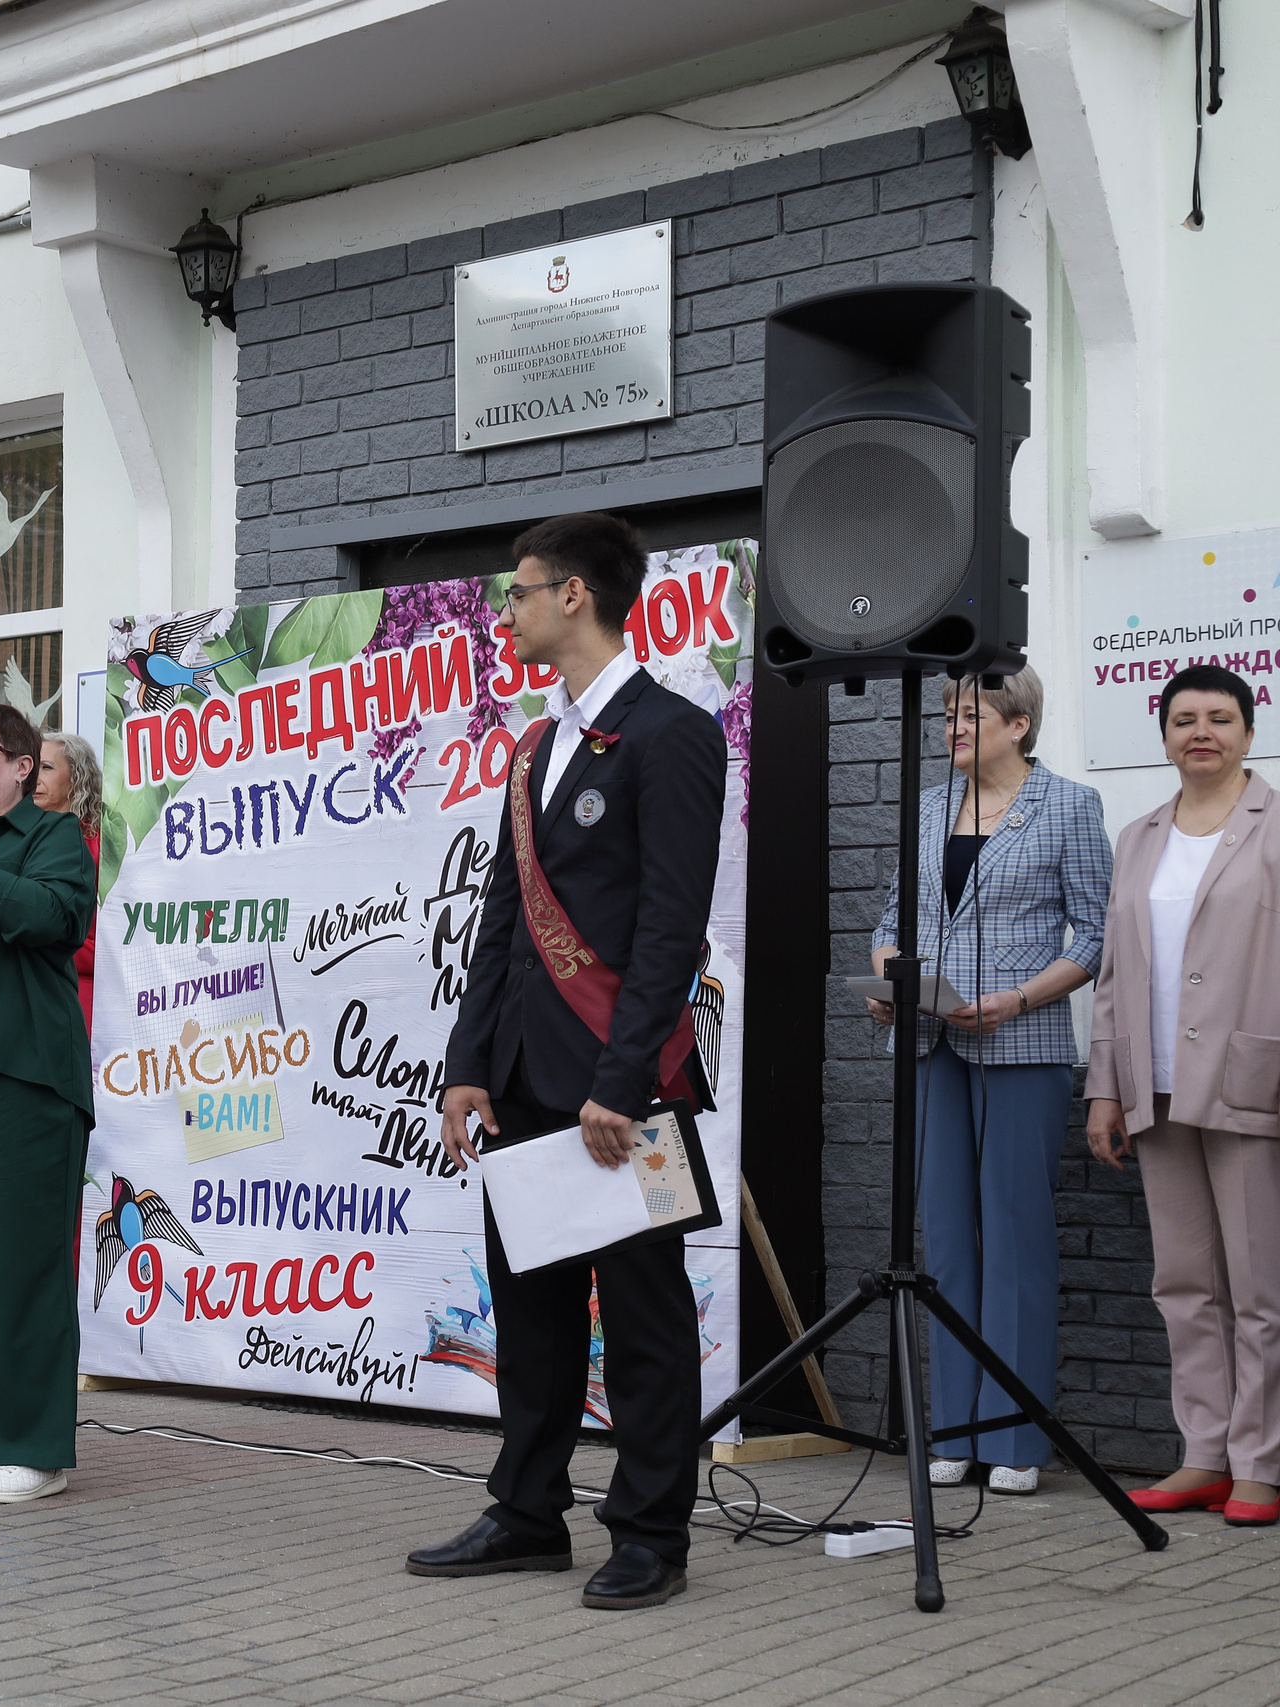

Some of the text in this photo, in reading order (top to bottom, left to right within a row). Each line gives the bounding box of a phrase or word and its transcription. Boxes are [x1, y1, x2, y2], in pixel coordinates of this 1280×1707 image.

[475, 284, 660, 326] Администрация города Нижнего Новгорода
[510, 304, 620, 332] Департамент образования
[475, 324, 647, 366] МУНИЦИПАЛЬНОЕ БЮДЖЕТНОЕ
[493, 342, 627, 375] ОБЩЕОБРАЗОВАТЕЛЬНОЕ
[522, 362, 596, 384] УЧРЕЖДЕНИЕ
[474, 381, 649, 429] «ШКОЛА № 75»
[1093, 618, 1280, 652] ФЕДЕРАЛЬНЫЙ ПР
[1094, 658, 1179, 686] УСПЕХ
[126, 627, 473, 786] ПОСЛЕДНИЙ
[166, 742, 414, 861] ВЫПУСК
[123, 898, 290, 945] УЧИТЕЛЯ!
[293, 882, 412, 963] Мечтай
[533, 905, 593, 980] 2025
[137, 962, 265, 1017] ВЫ ЛУЧШИЕ!
[103, 1029, 311, 1097] СПАСИБО
[198, 1093, 272, 1133] ВАМ!
[311, 1081, 384, 1129] твой
[667, 1117, 686, 1159] классы
[191, 1178, 411, 1236] ВЫПУСКНИК
[126, 1244, 375, 1325] 9 класс
[238, 1316, 419, 1402] Действуй!
